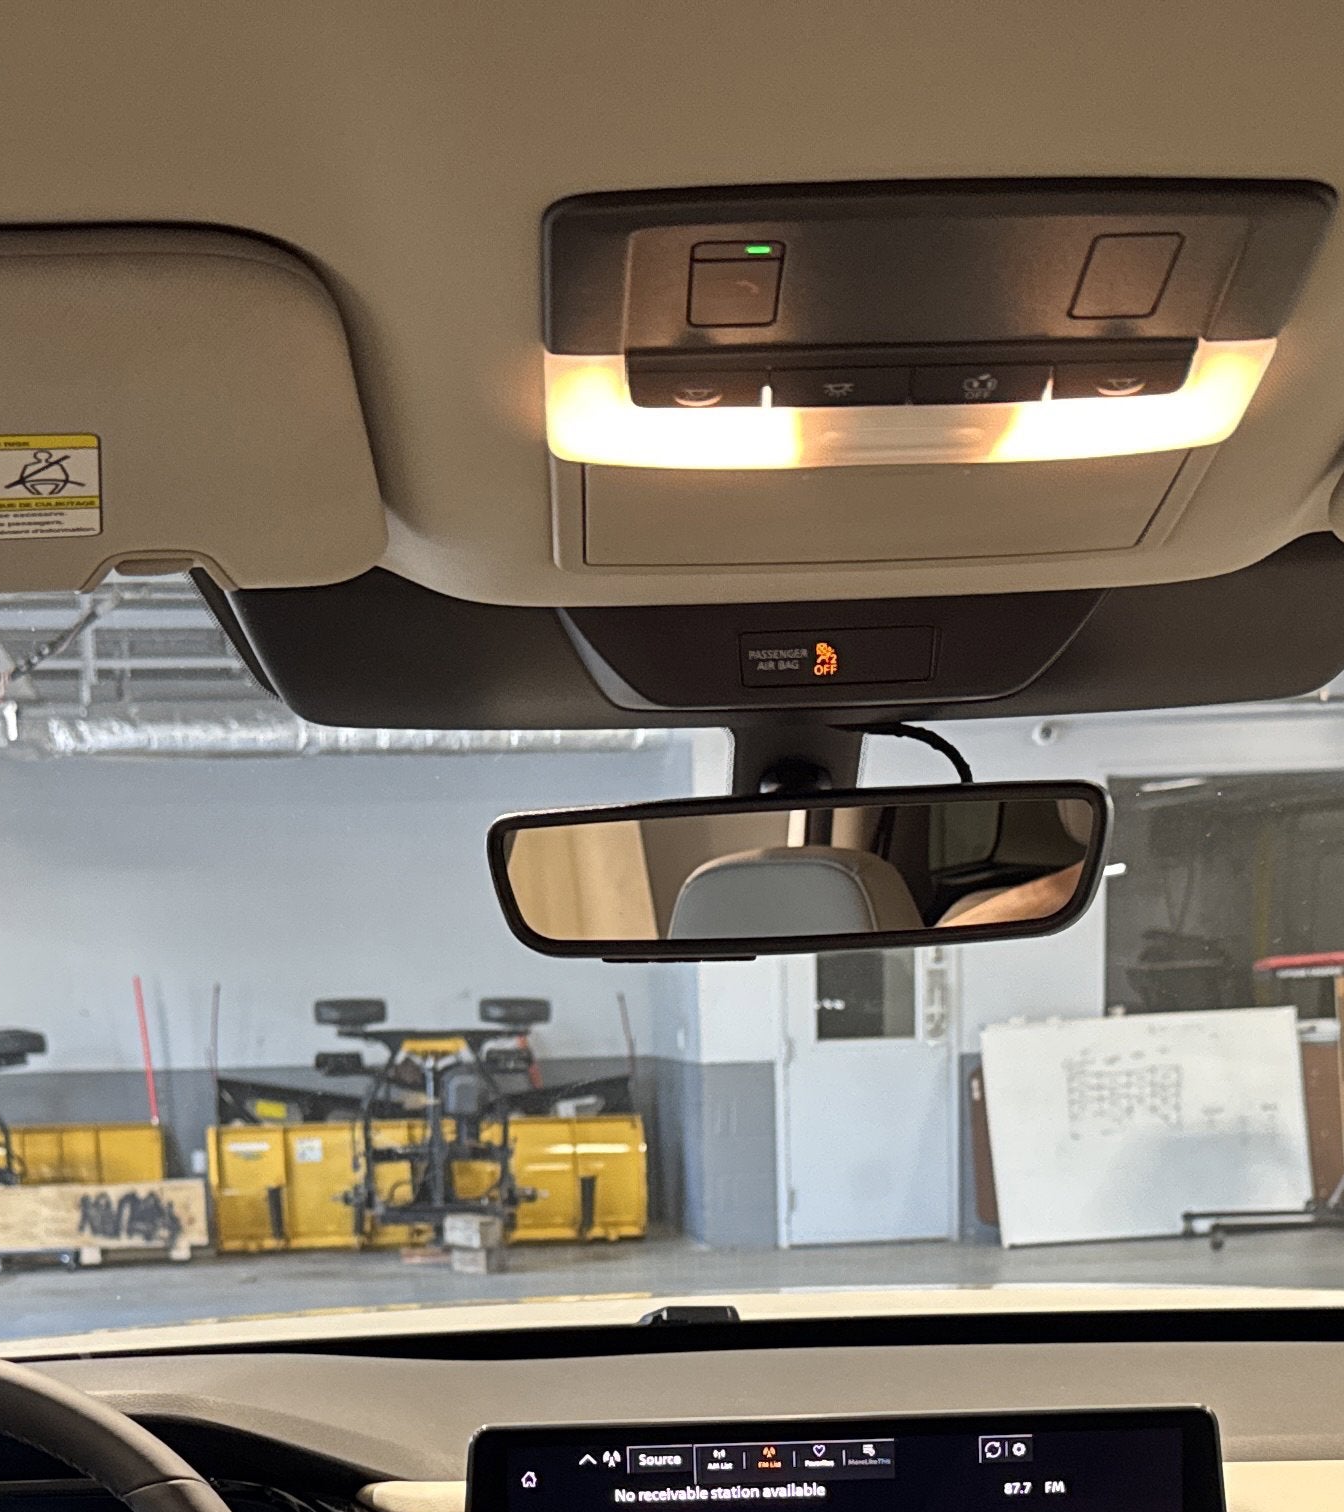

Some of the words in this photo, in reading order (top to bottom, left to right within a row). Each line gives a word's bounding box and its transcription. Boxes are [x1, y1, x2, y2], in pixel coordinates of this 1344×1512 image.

[748, 648, 808, 660] PASSENGER
[757, 660, 776, 671] AIR
[777, 660, 800, 670] BAG
[813, 664, 838, 676] OFF
[638, 1453, 682, 1466] Source
[707, 1462, 720, 1470] AM
[721, 1461, 733, 1470] List
[757, 1461, 769, 1469] FM
[770, 1461, 782, 1469] List
[614, 1488, 636, 1503] No
[638, 1485, 709, 1502] receivable
[710, 1485, 760, 1500] station
[762, 1481, 826, 1499] available
[1003, 1481, 1032, 1495] 87.7
[1044, 1480, 1066, 1494] FM
